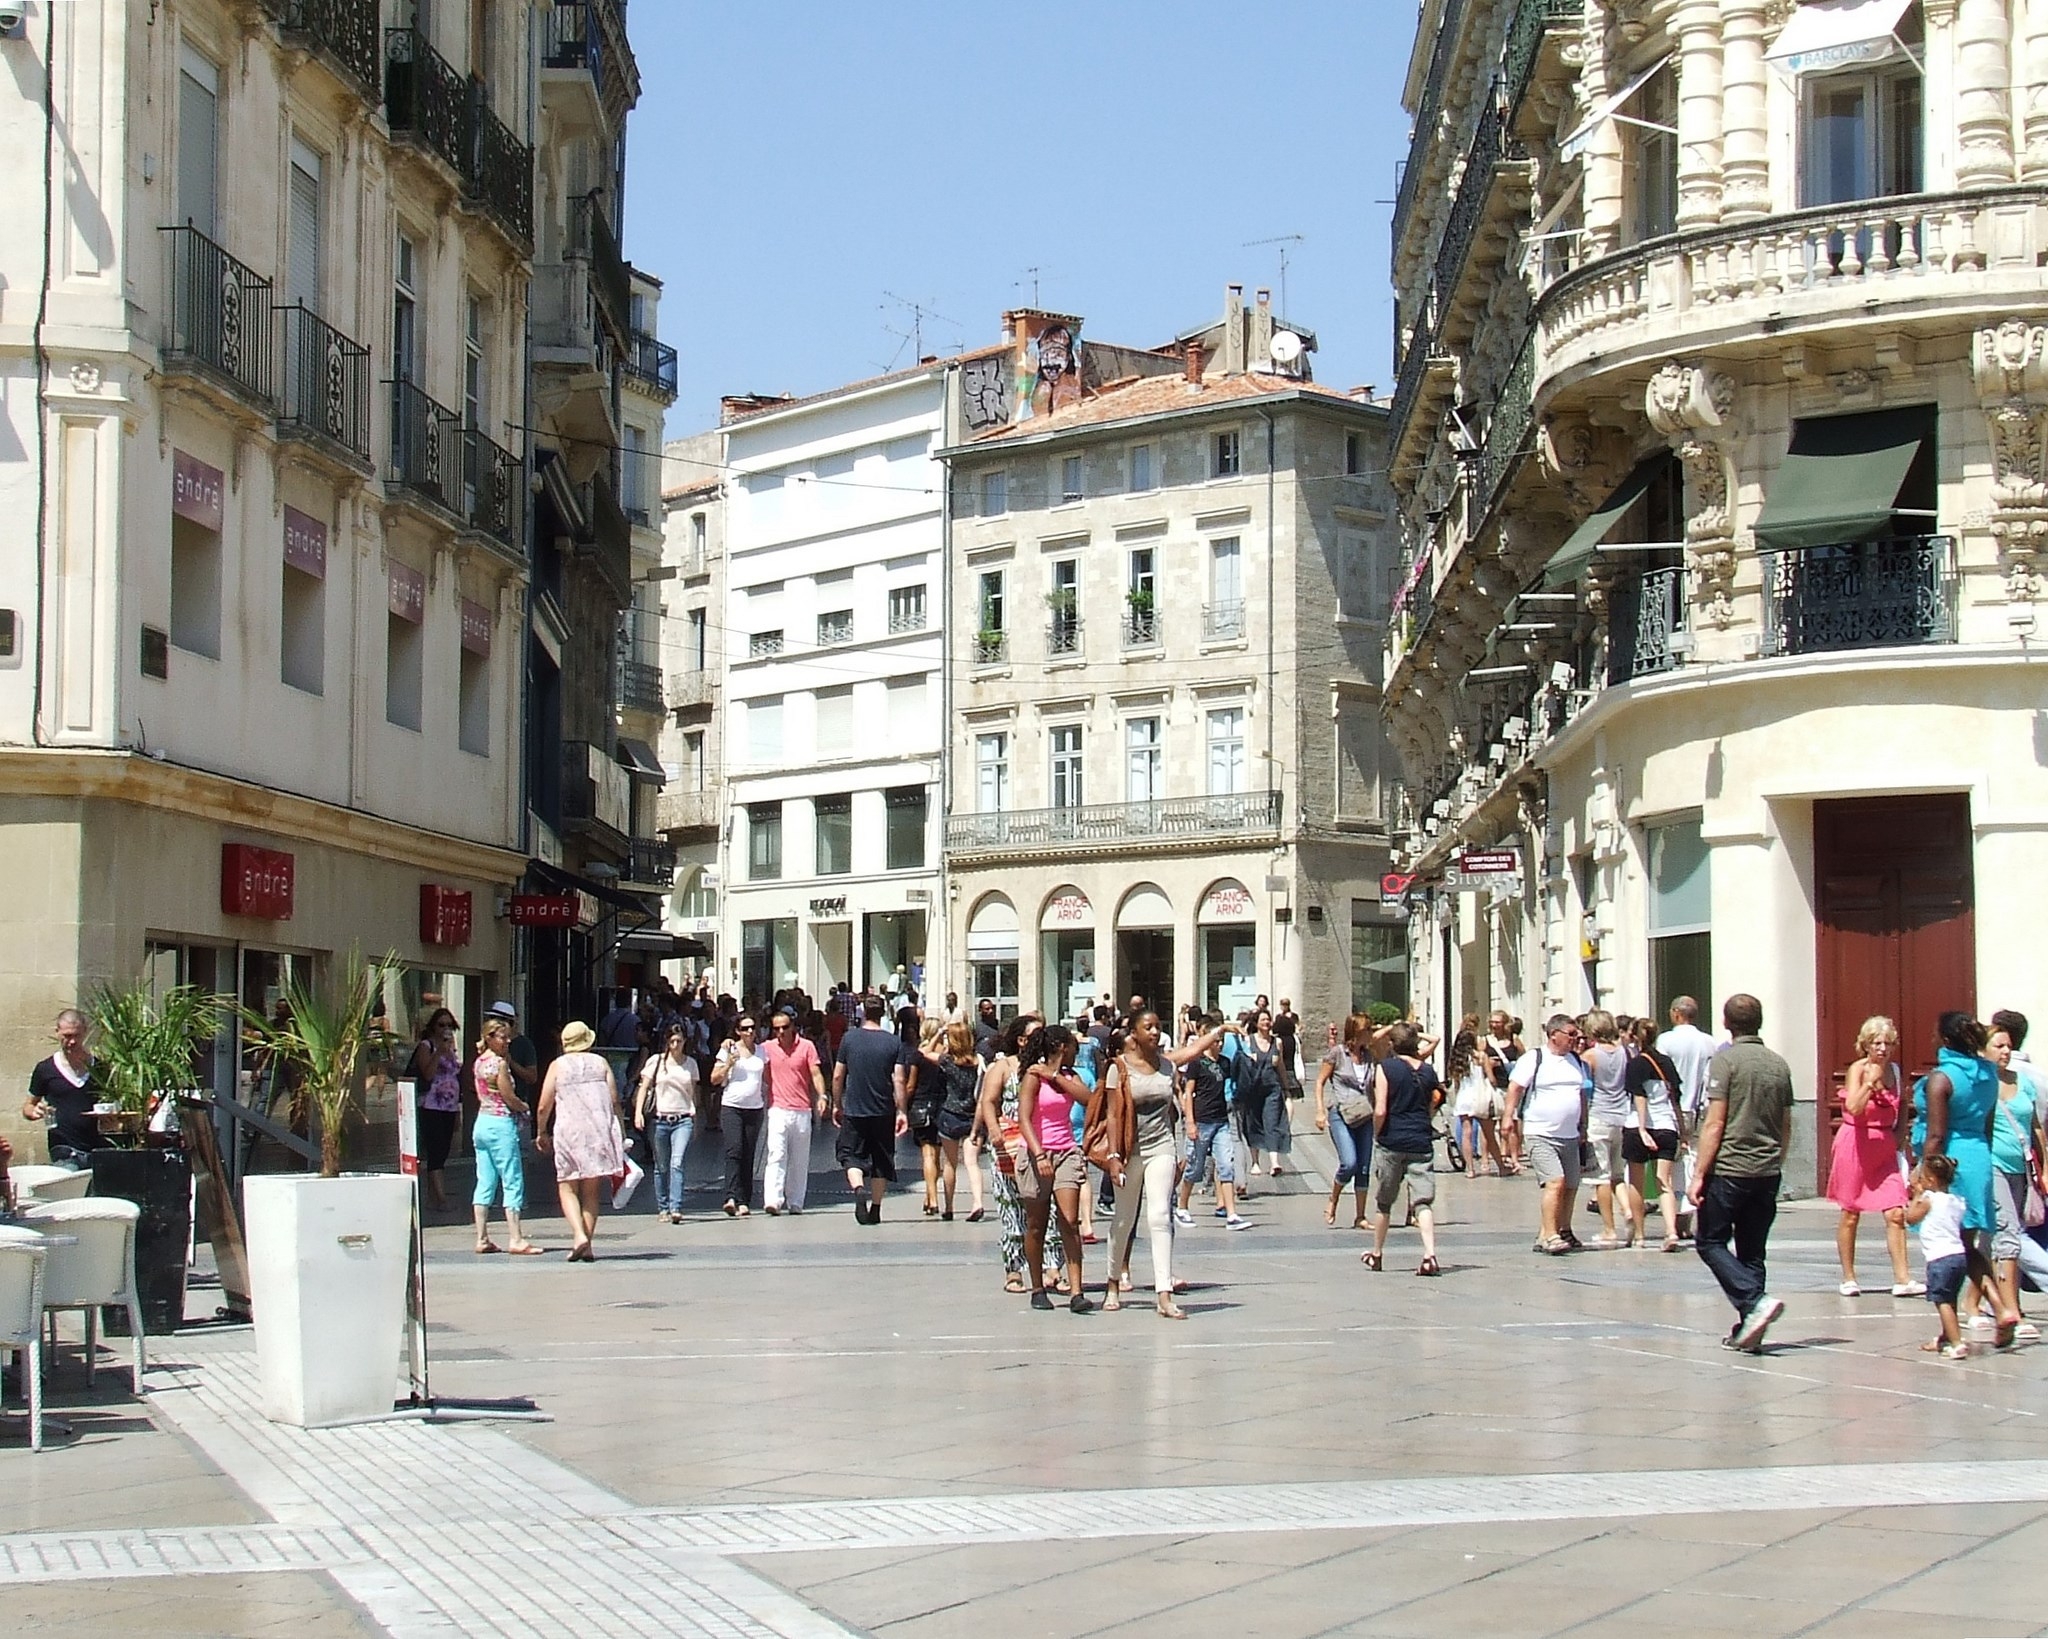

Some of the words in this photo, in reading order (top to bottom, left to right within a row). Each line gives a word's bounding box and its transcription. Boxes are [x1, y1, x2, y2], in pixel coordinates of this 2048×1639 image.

[1804, 41, 1870, 65] BARCLAYS
[176, 472, 219, 511] andré
[286, 526, 323, 560] andré
[244, 866, 288, 900] andré
[1051, 896, 1087, 909] FRANCE
[1209, 890, 1248, 903] FRANCE
[514, 902, 571, 920] andré
[1057, 909, 1082, 921] ARNO
[1216, 903, 1243, 916] ARNO
